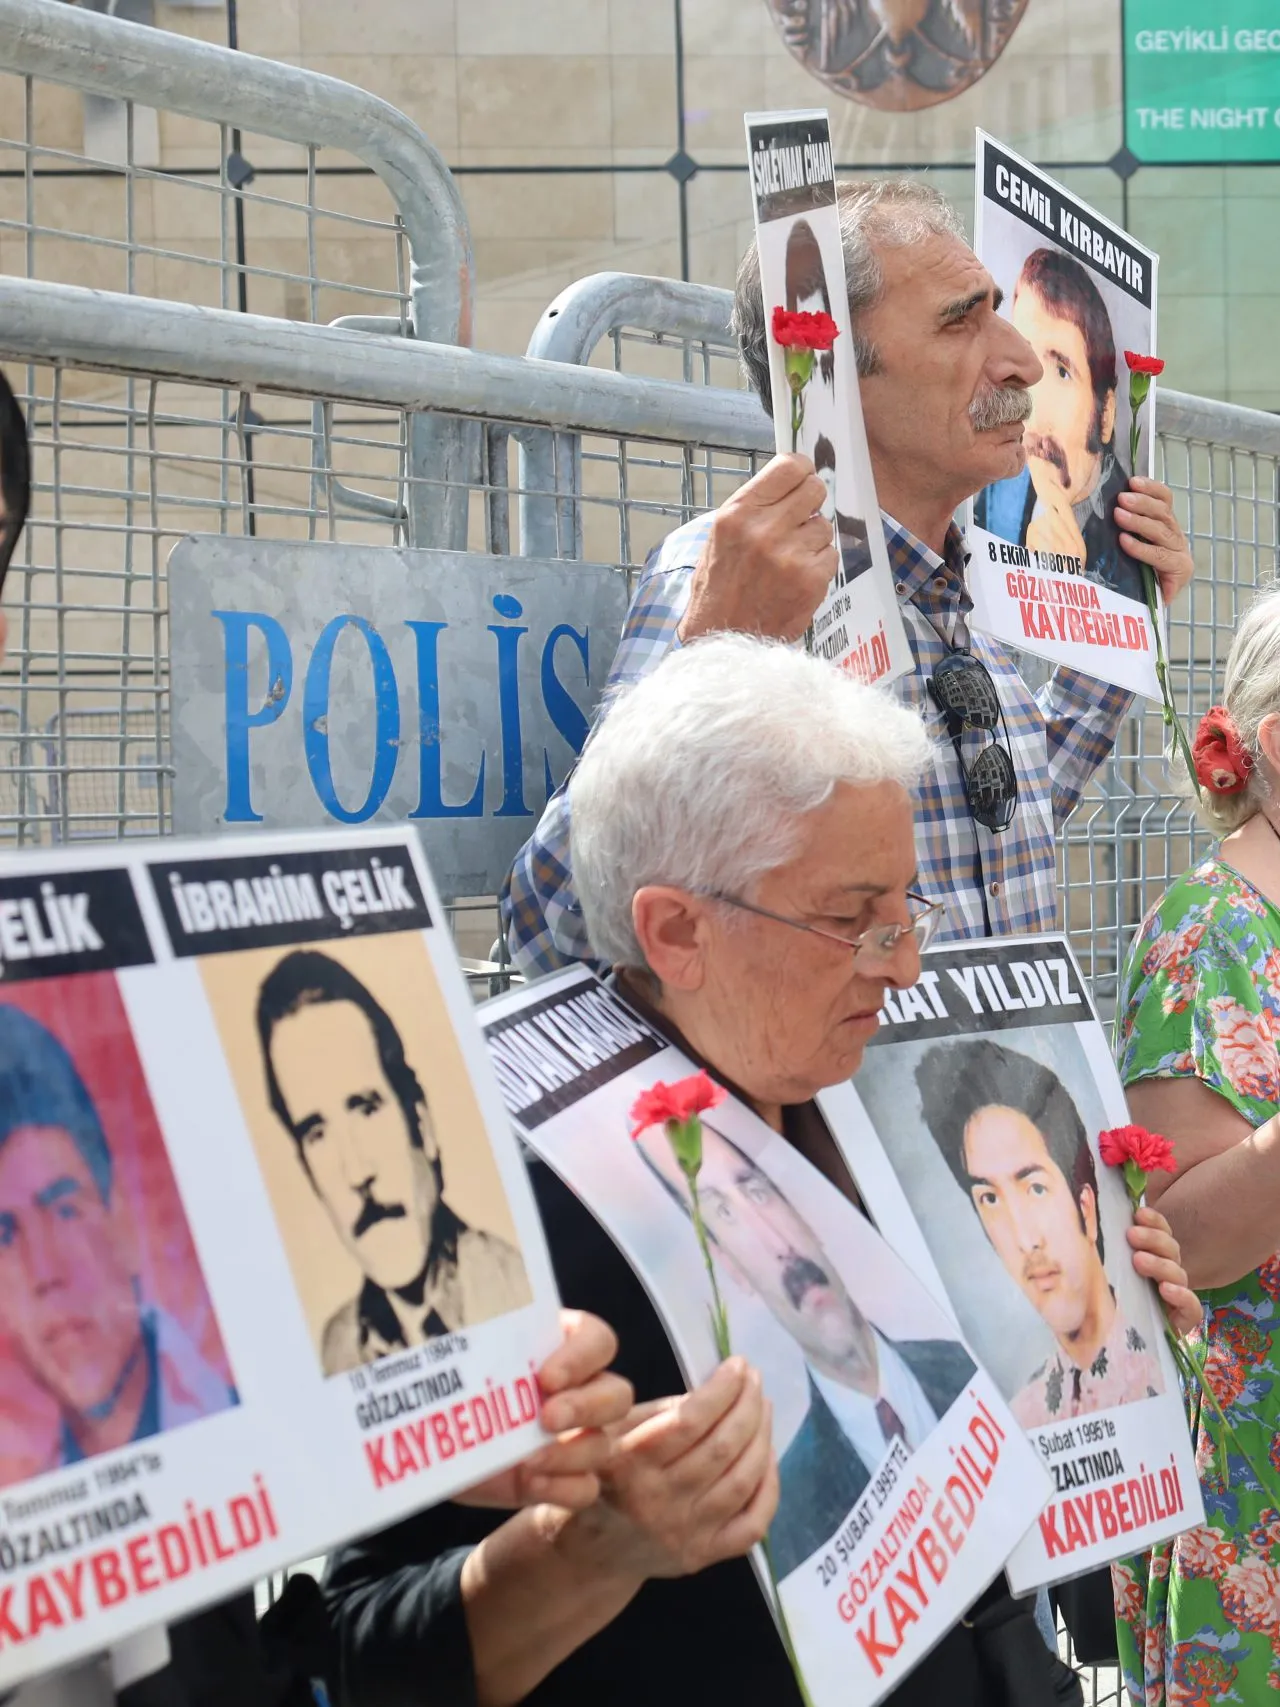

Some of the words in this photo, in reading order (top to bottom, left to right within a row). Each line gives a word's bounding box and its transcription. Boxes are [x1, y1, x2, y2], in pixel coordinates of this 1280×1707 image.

[1135, 25, 1229, 51] GEYİKLİ
[1136, 107, 1184, 129] THE
[1190, 107, 1268, 129] NIGHT
[1060, 207, 1143, 294] KIRBAYIR
[988, 541, 997, 562] 8
[1033, 551, 1083, 576] 1980'DE
[1005, 569, 1101, 610] GÖZALTINDA
[210, 594, 590, 824] POLİS
[0, 881, 105, 964] ELİK
[168, 864, 323, 934] İBRAHİM
[322, 857, 416, 930] ÇELİK
[877, 970, 949, 1026] RAT
[946, 958, 1082, 1014] YILDIZ
[355, 1367, 463, 1430] GÖZALTINDA
[364, 1360, 546, 1491] KAYBEDİLDİ
[1038, 1431, 1076, 1460] Şubat
[1051, 1447, 1124, 1493] ZALTINDA
[0, 1490, 150, 1572] ÖZALTINDA
[816, 1555, 838, 1588] 20
[835, 1502, 876, 1566] ŞUBAT
[855, 1389, 1006, 1678] KAYBEDİLDİ
[1038, 1453, 1184, 1560] KAYBEDİLDİ
[836, 1475, 933, 1624] GÖZALTINDA
